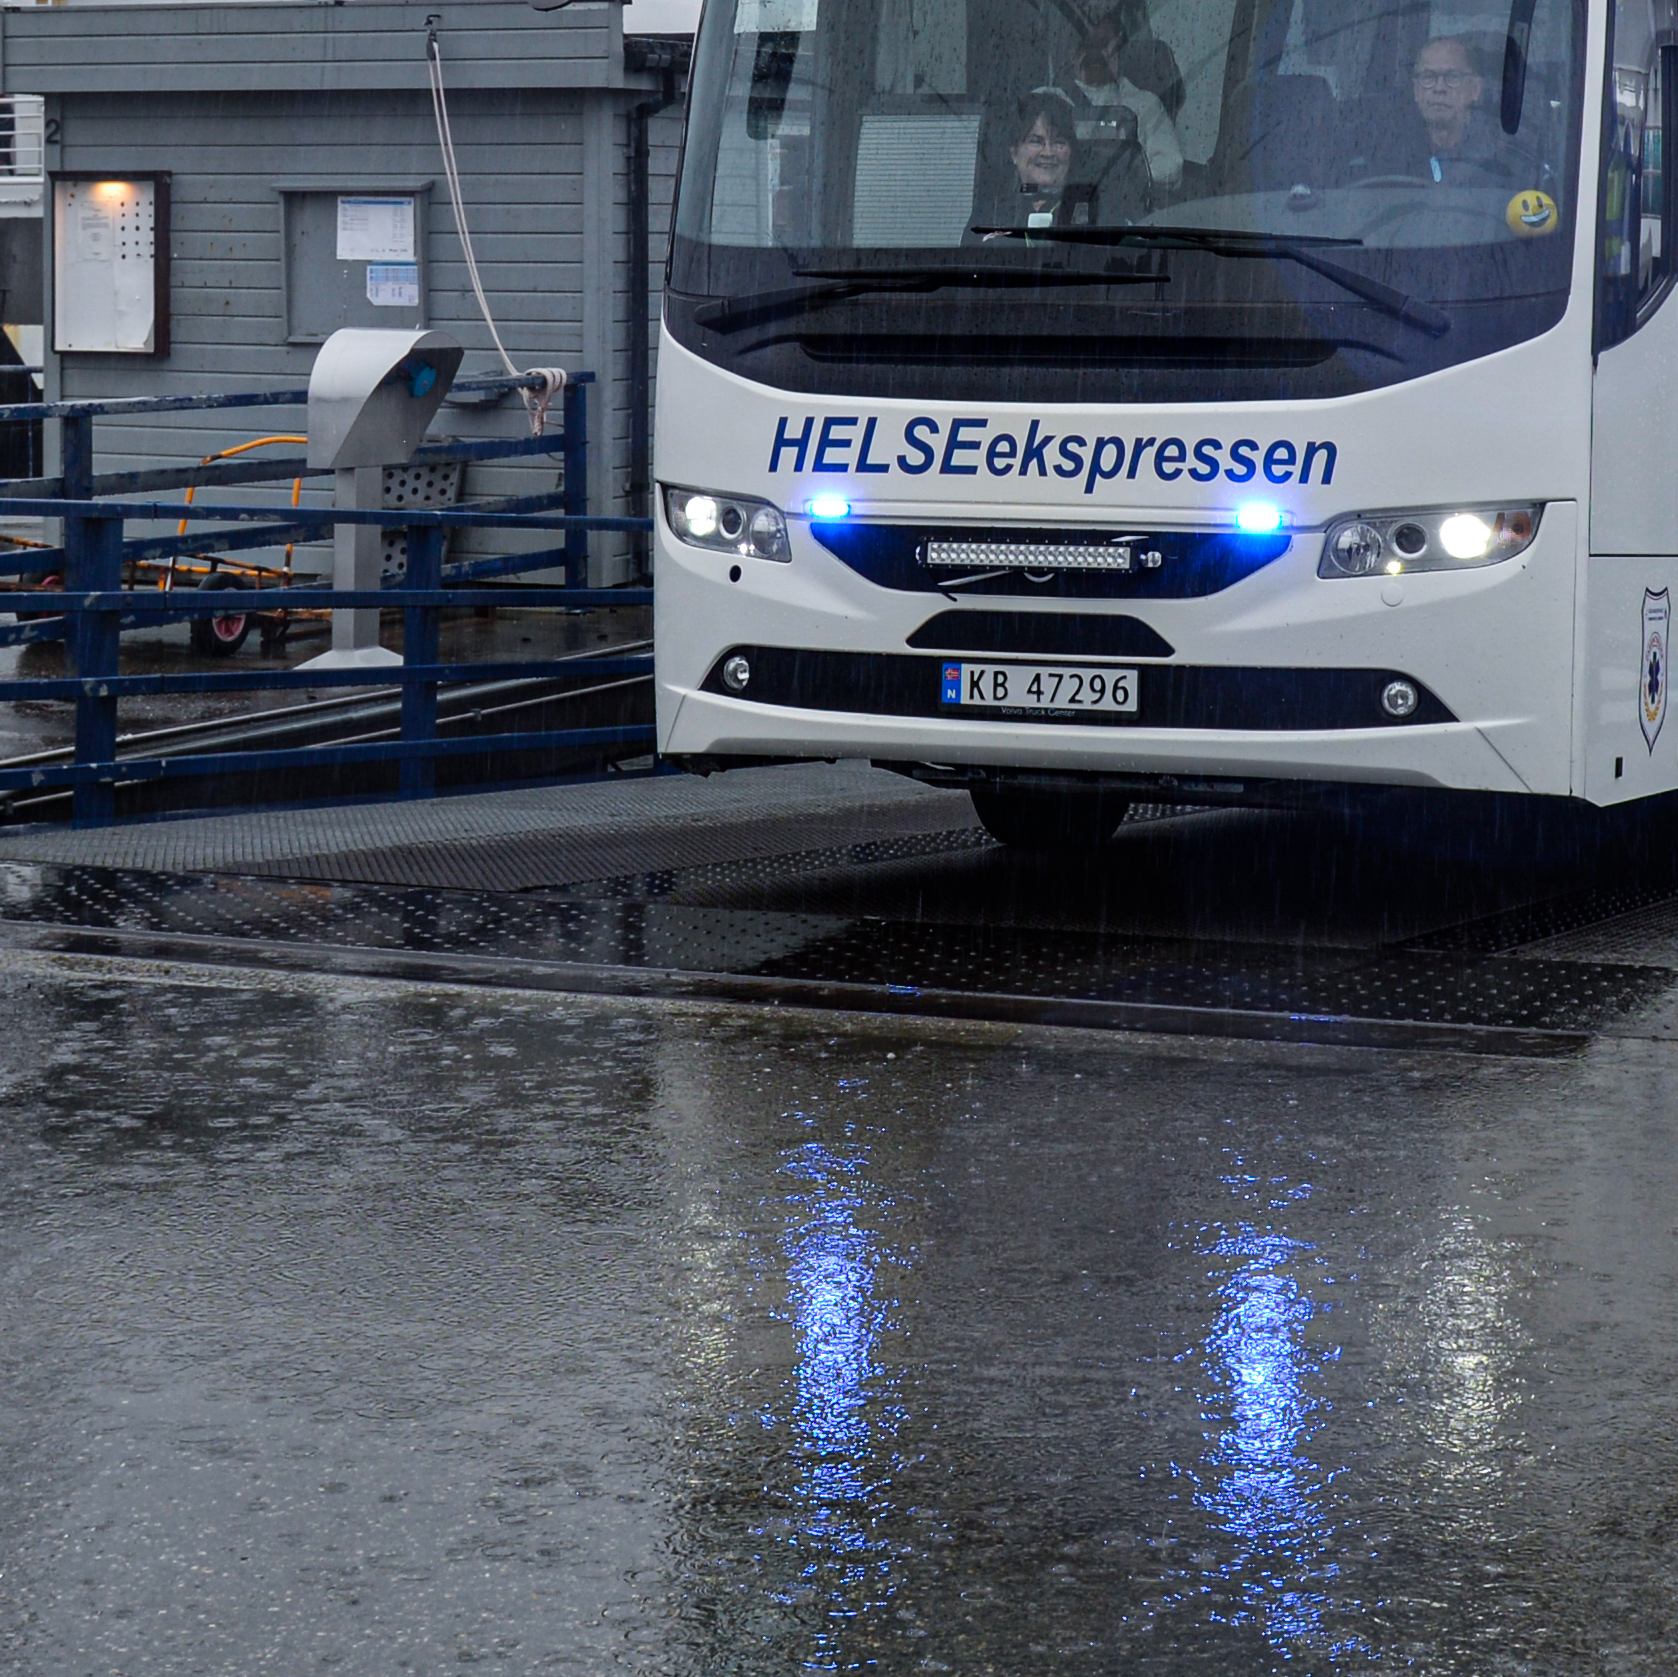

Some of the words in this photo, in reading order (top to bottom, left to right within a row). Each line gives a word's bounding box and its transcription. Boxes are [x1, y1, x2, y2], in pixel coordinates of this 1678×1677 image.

[45, 118, 61, 145] 2
[768, 416, 1338, 495] HELSEekspressen
[947, 689, 957, 699] N
[968, 669, 1009, 701] KB
[1026, 672, 1130, 706] 47296
[1000, 706, 1023, 715] Volvo
[1025, 707, 1045, 716] Truck
[1047, 708, 1077, 717] Center
